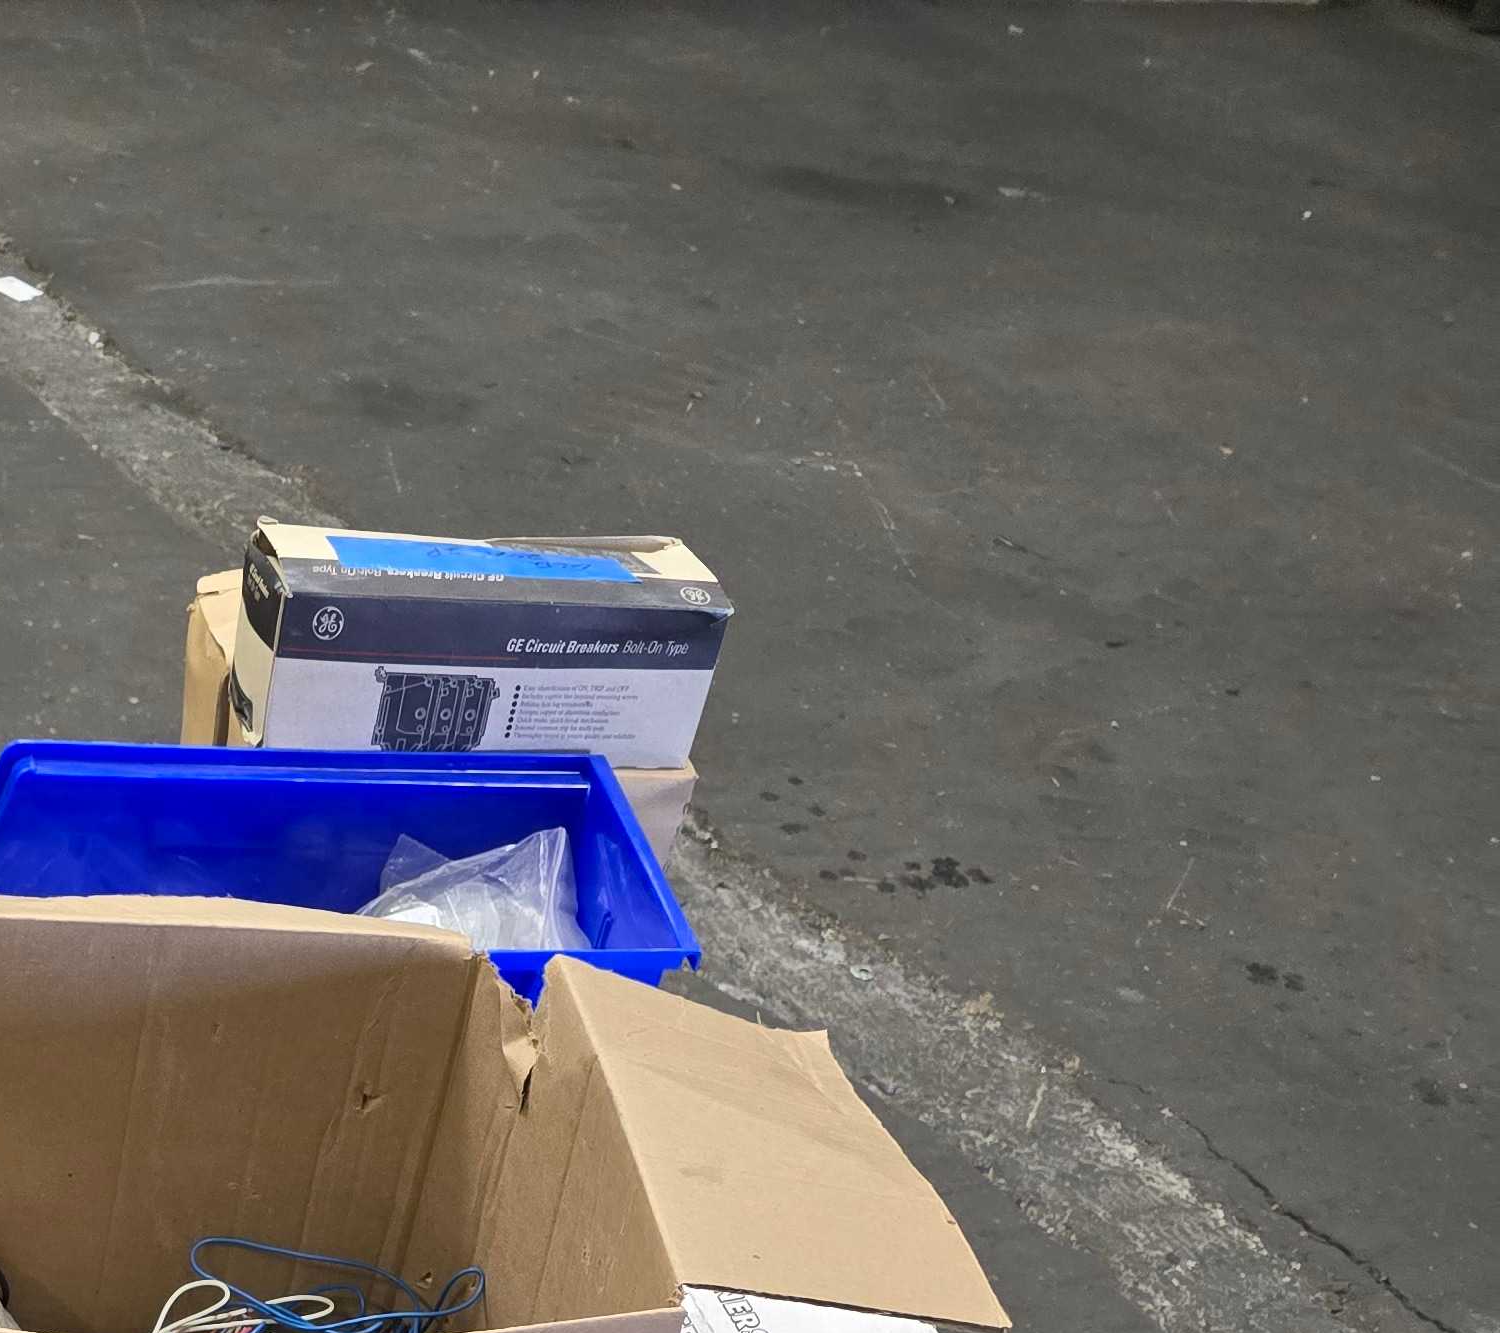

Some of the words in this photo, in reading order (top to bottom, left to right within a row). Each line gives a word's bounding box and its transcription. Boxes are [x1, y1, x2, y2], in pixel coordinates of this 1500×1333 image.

[506, 638, 525, 654] GE
[526, 638, 564, 654] Circuit
[566, 639, 619, 655] Breakers
[622, 640, 663, 655] Bolt-On
[666, 641, 689, 657] Type
